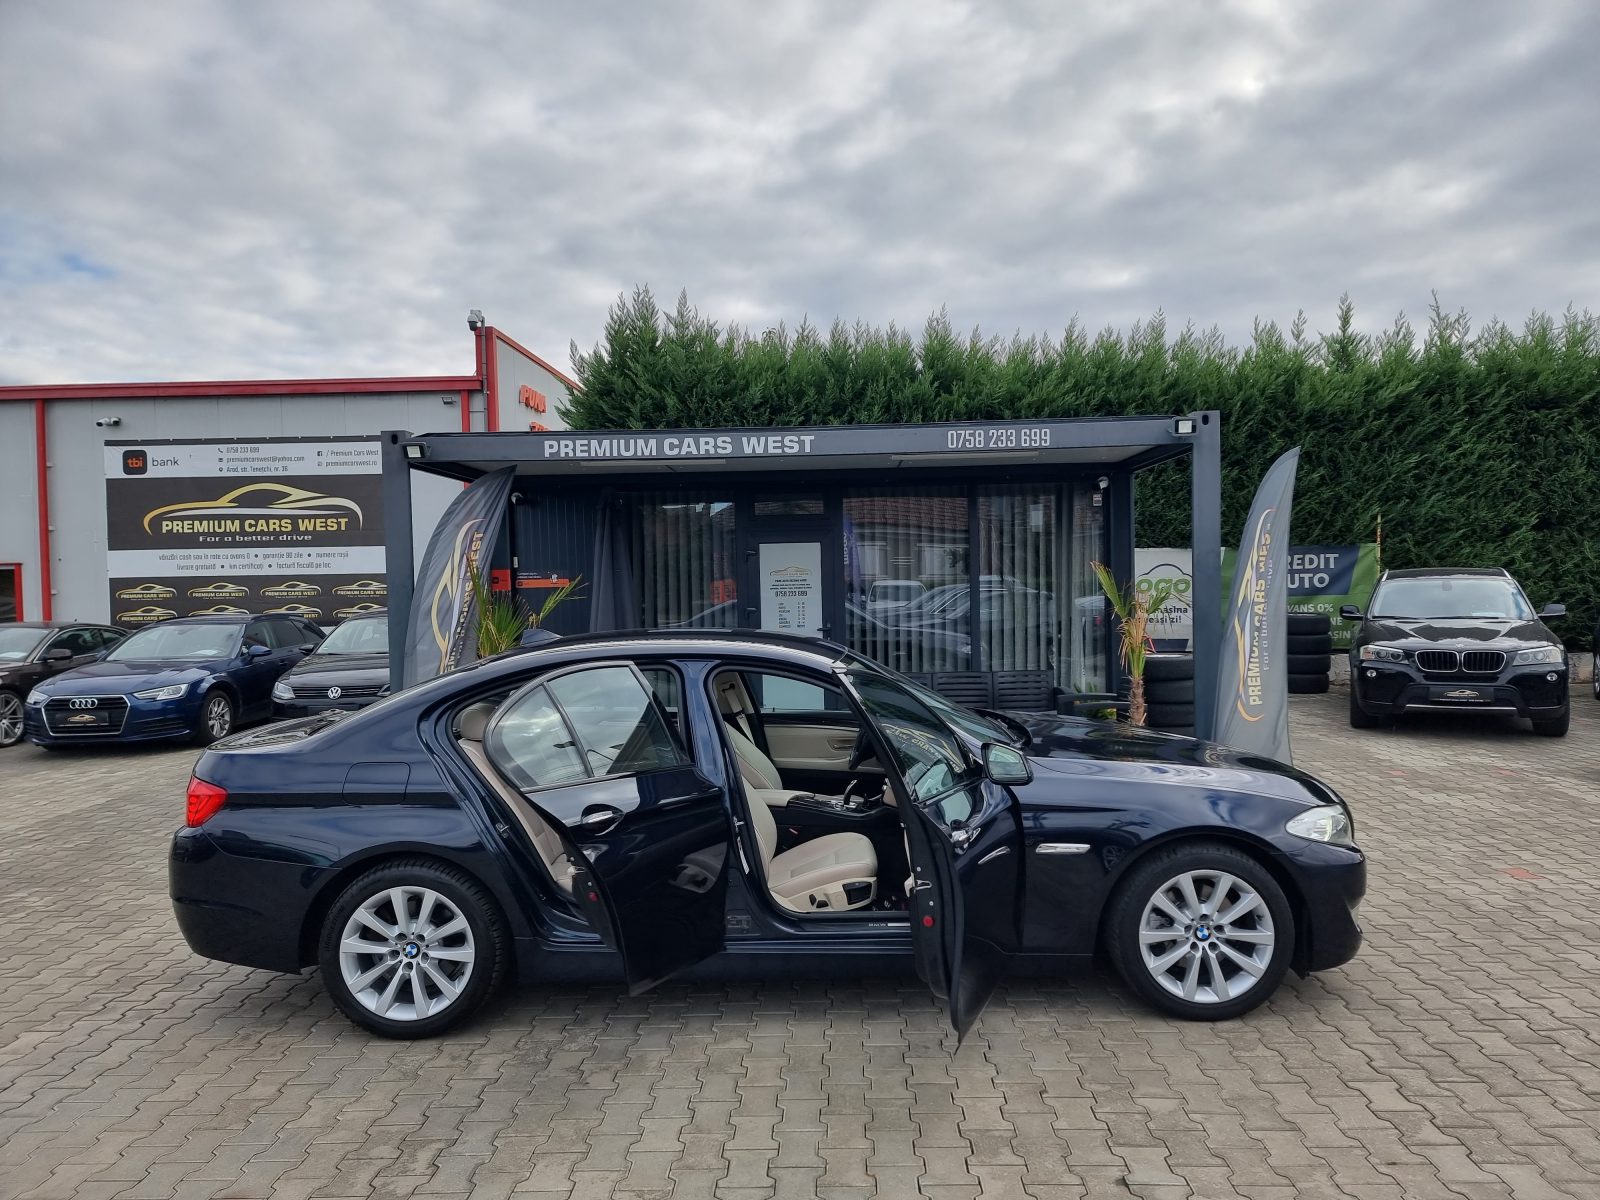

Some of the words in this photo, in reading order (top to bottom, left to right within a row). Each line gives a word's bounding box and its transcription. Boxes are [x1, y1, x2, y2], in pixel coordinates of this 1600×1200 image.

[947, 430, 985, 448] 0758
[988, 430, 1016, 448] 233
[1021, 428, 1050, 447] 699
[544, 438, 657, 458] PREMIUM
[663, 436, 733, 456] CARS
[741, 435, 815, 454] WEST
[127, 457, 143, 468] tbi
[151, 457, 180, 467] bank
[162, 519, 240, 534] PREMIUM
[244, 519, 292, 532] CARS
[298, 518, 349, 531] WEST
[235, 534, 276, 542] better
[1288, 573, 1330, 589] UTO
[1288, 604, 1314, 613] VANS
[1317, 604, 1334, 612] 0%
